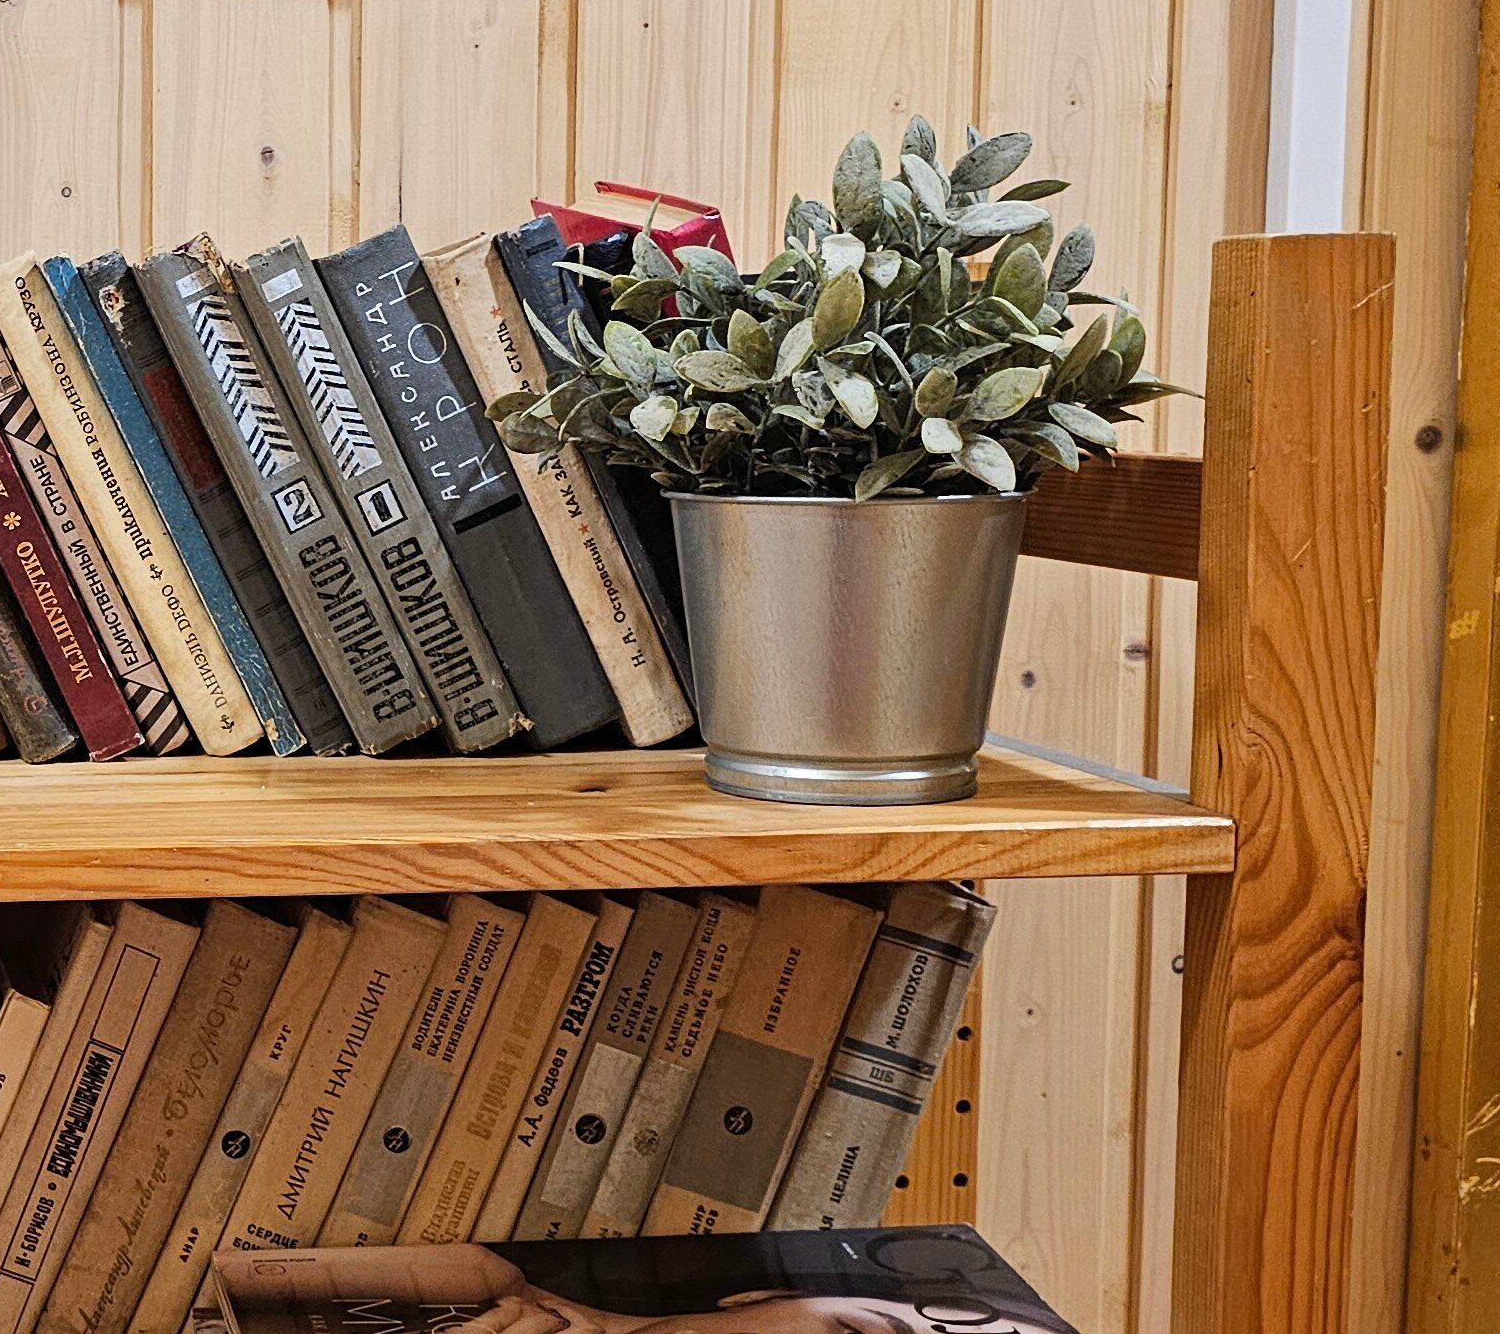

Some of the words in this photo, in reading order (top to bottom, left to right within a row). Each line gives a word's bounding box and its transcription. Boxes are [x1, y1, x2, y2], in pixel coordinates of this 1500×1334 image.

[377, 256, 507, 493] КРОН
[492, 320, 524, 375] СТАЛЬ
[352, 277, 460, 505] АЛЕКСАНДР
[29, 453, 68, 517] СТРАНЕ
[282, 486, 314, 524] 2
[366, 489, 393, 523] 1
[559, 484, 582, 517] КАК
[60, 520, 75, 533] В
[67, 537, 139, 669] ЕДИНСТВЕННЫЙ
[581, 536, 627, 624] Островский
[619, 626, 637, 645] А.
[628, 649, 646, 667] Н.
[410, 985, 445, 1050] ВОДИТЕЛИ
[424, 985, 464, 1057] ЕКАТЕРИНА
[454, 918, 490, 984] ВОРОНИНА
[438, 973, 486, 1063] НЕИЗВЕСТНЫЙ
[476, 923, 506, 972] СОЛДАТ
[605, 983, 632, 1033] КОГДА
[620, 947, 663, 1039] СЛИВАЮТСЯ
[664, 1000, 690, 1053] КАМЕНЬ
[682, 946, 708, 998] ЧИСТОЙ
[680, 986, 713, 1058] СЕДЬМОЕ
[705, 941, 729, 982] НЕБО
[761, 946, 802, 1033] ИЗБРАННОЕ
[268, 1023, 292, 1061] КРУГ
[510, 1107, 545, 1147] А.А.
[558, 941, 618, 1037] РАЗГРОМ
[635, 1004, 659, 1043] РЕКИ
[271, 1102, 336, 1220] ДМИТРИЙ
[322, 966, 391, 1099] НАГИШКИН
[828, 1143, 861, 1204] ЦЕЛИНА
[177, 1225, 201, 1263] АНАР
[245, 1223, 299, 1250] СЕРДЦЕ
